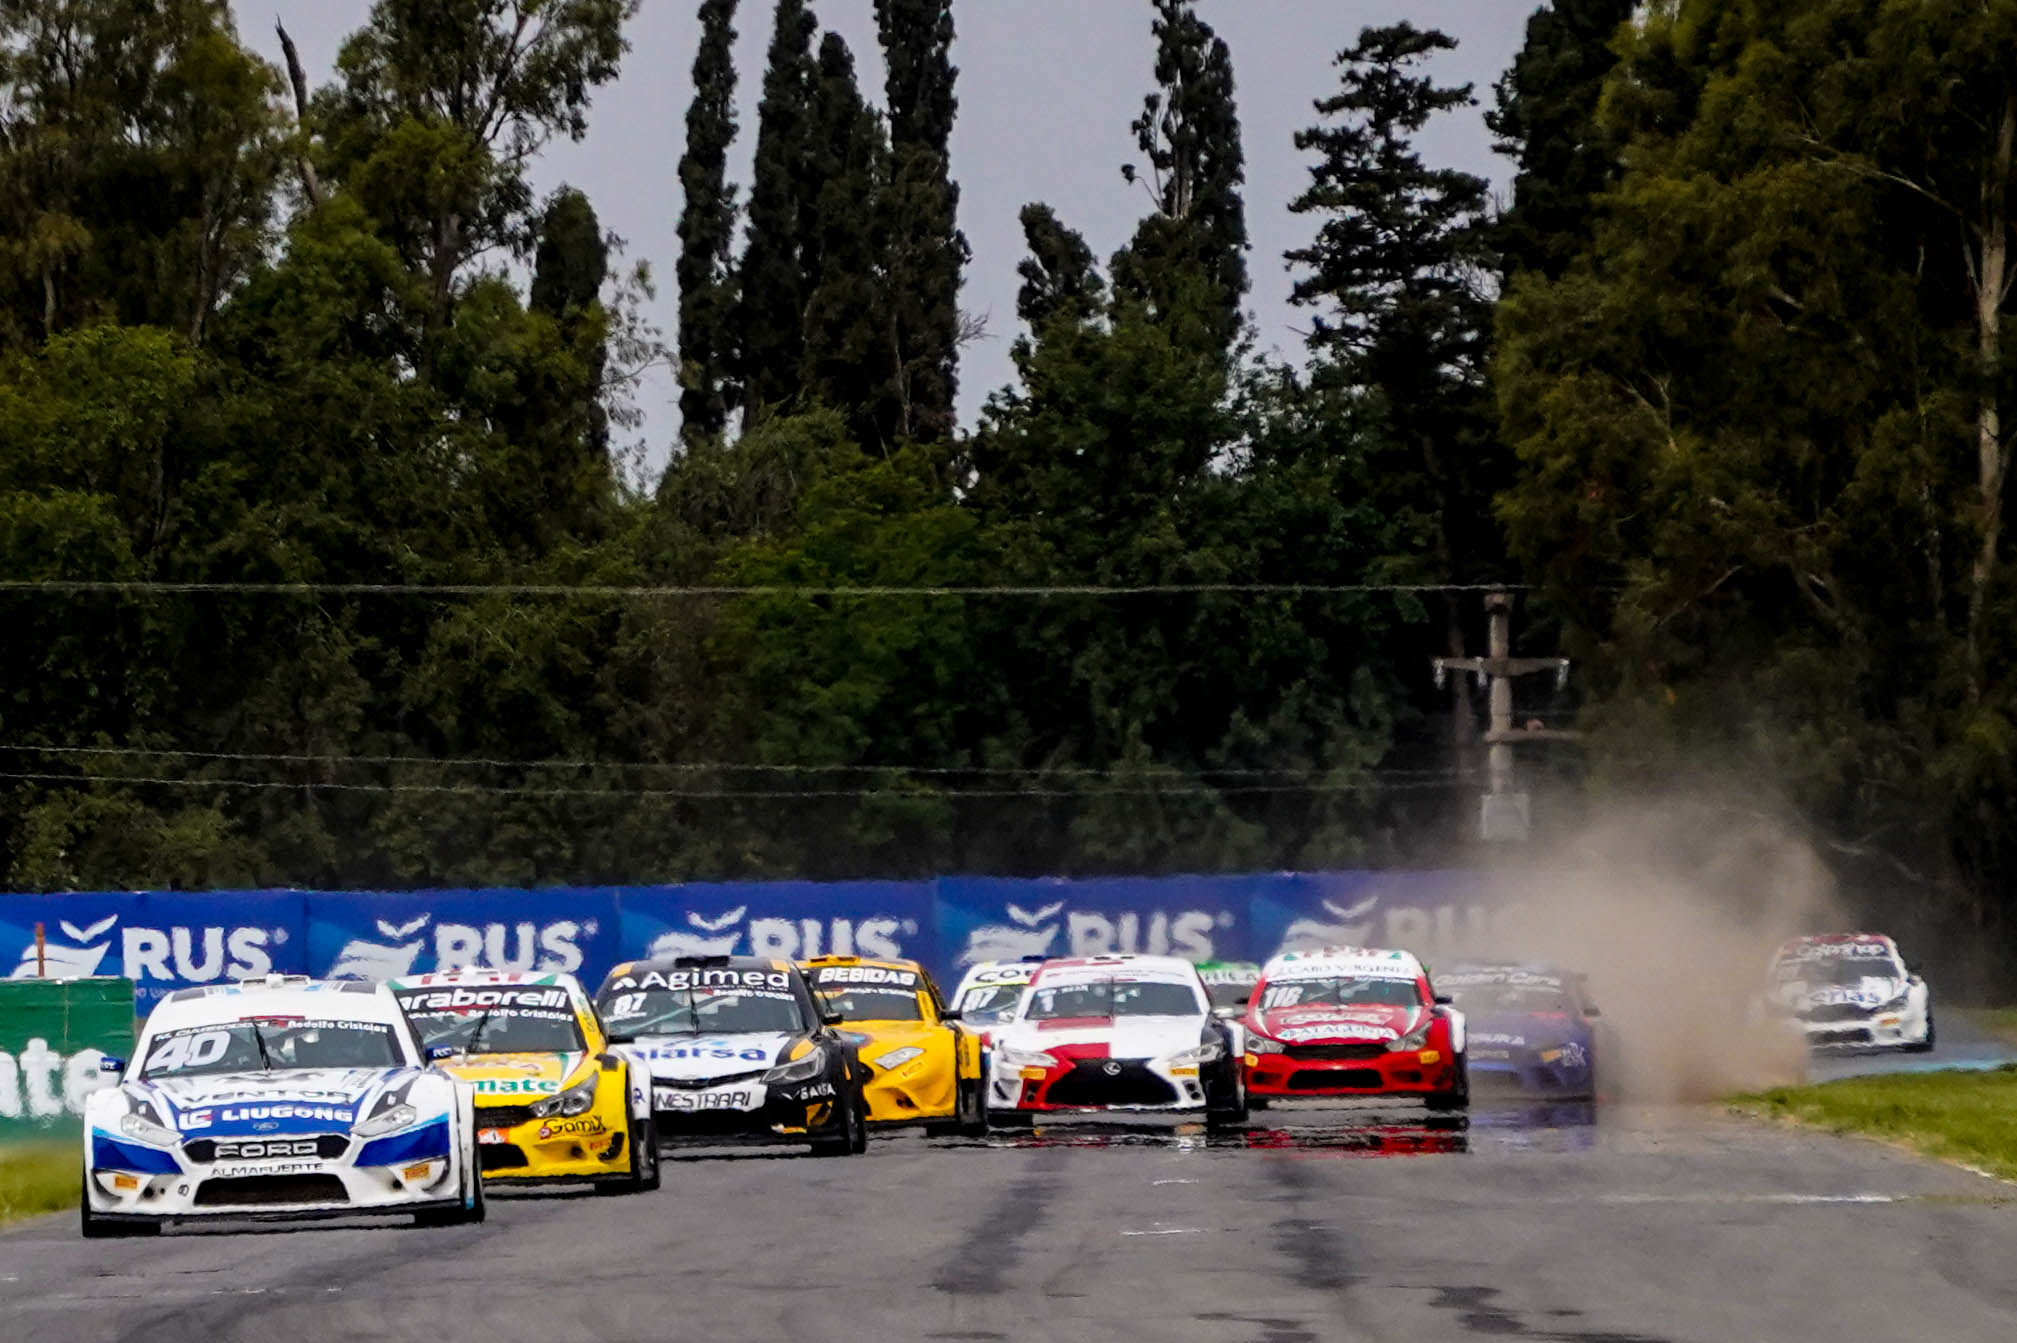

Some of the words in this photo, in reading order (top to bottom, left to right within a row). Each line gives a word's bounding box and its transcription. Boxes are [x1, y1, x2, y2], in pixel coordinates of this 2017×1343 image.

[640, 968, 790, 991] Agimed
[819, 967, 916, 985] BEBIDAS
[145, 1030, 232, 1073] 40
[214, 1141, 319, 1159] FORD
[211, 1162, 324, 1178] ALMAFUERTE
